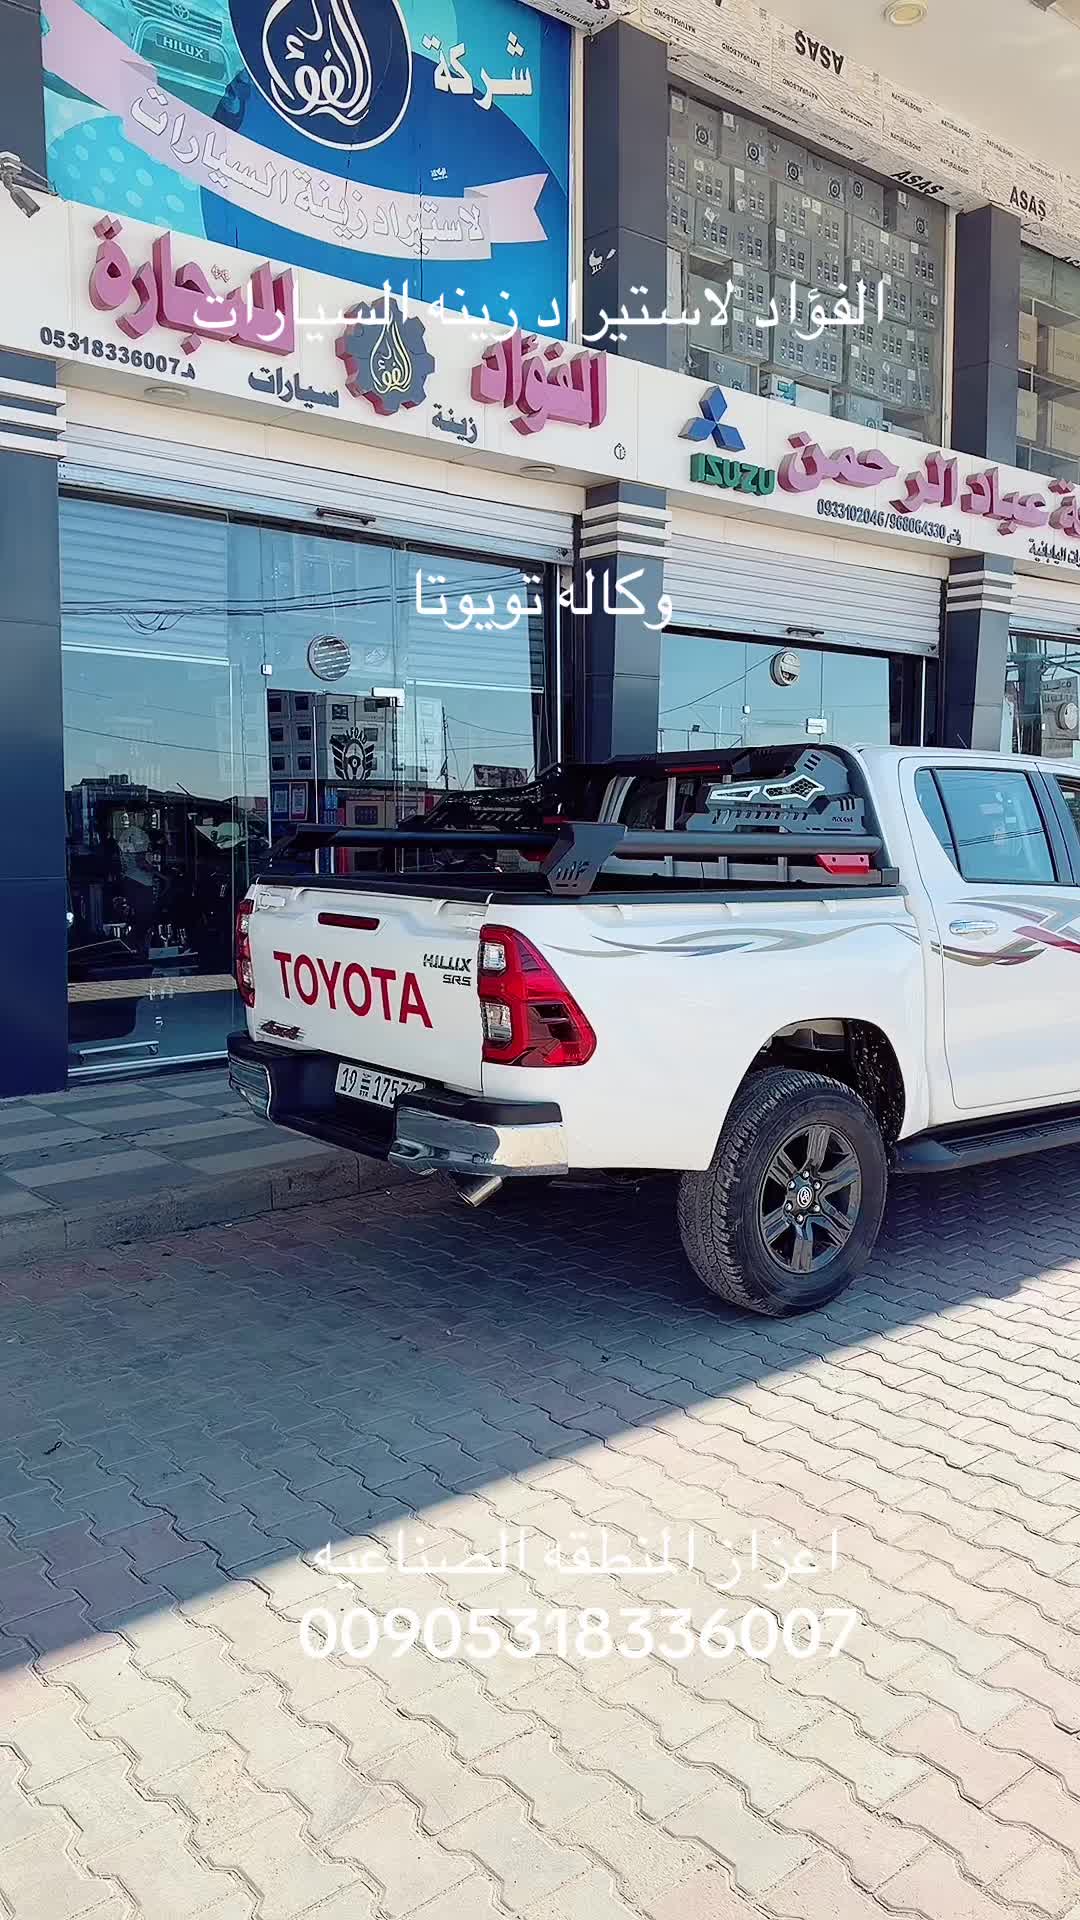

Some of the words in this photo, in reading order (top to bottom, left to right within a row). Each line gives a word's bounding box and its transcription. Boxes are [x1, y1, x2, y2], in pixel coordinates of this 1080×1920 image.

[162, 36, 205, 60] HILUX
[421, 31, 533, 110] شركة
[130, 86, 288, 204] السيارات
[292, 167, 369, 240] زينة
[372, 200, 485, 256] لاستيراد
[39, 326, 180, 375] 05318336007
[247, 366, 340, 409] سيارات
[470, 326, 607, 436] الفؤاد
[431, 402, 478, 444] زينة
[690, 452, 777, 496] ISUZU
[777, 430, 959, 515] الرحمن
[961, 466, 1051, 536] عباد
[422, 953, 473, 973] HILUX
[442, 974, 473, 987] SRS
[272, 950, 434, 1029] TOYOTA
[340, 1067, 358, 1093] 19
